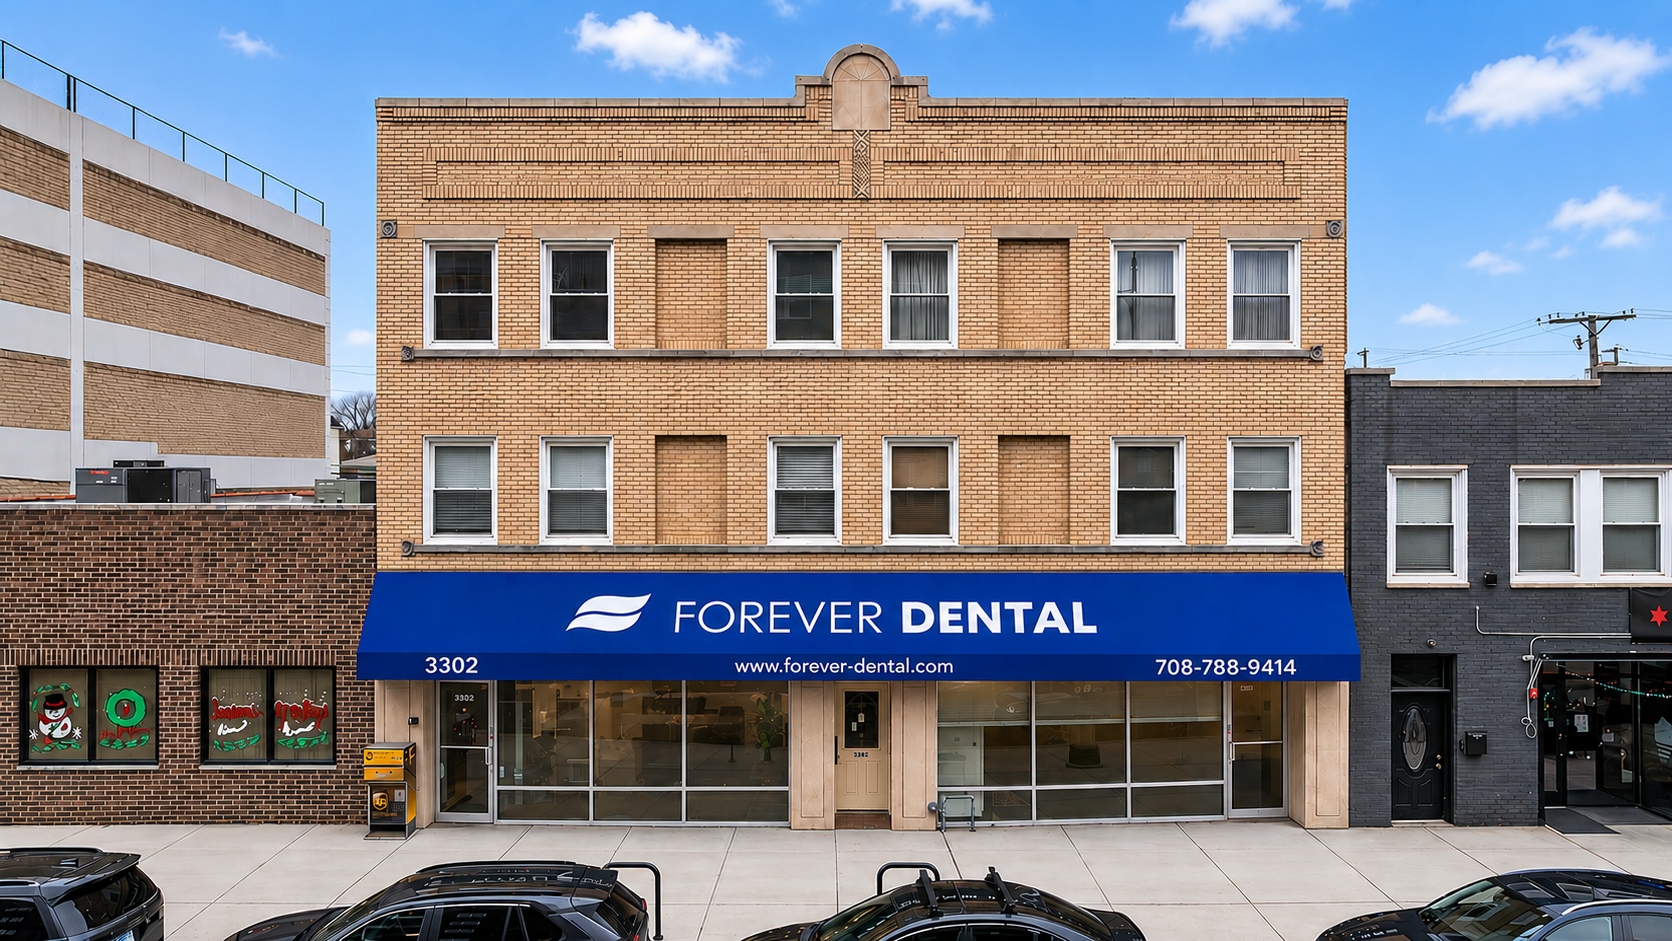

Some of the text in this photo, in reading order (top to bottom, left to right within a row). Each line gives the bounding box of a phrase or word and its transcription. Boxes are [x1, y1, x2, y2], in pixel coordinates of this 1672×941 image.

[674, 600, 1098, 634] FOREVER DENTAL
[425, 657, 478, 674] 3302
[734, 657, 954, 674] www.forever-dental.com
[1155, 658, 1297, 675] 708-788-9414
[454, 694, 475, 702] 3302
